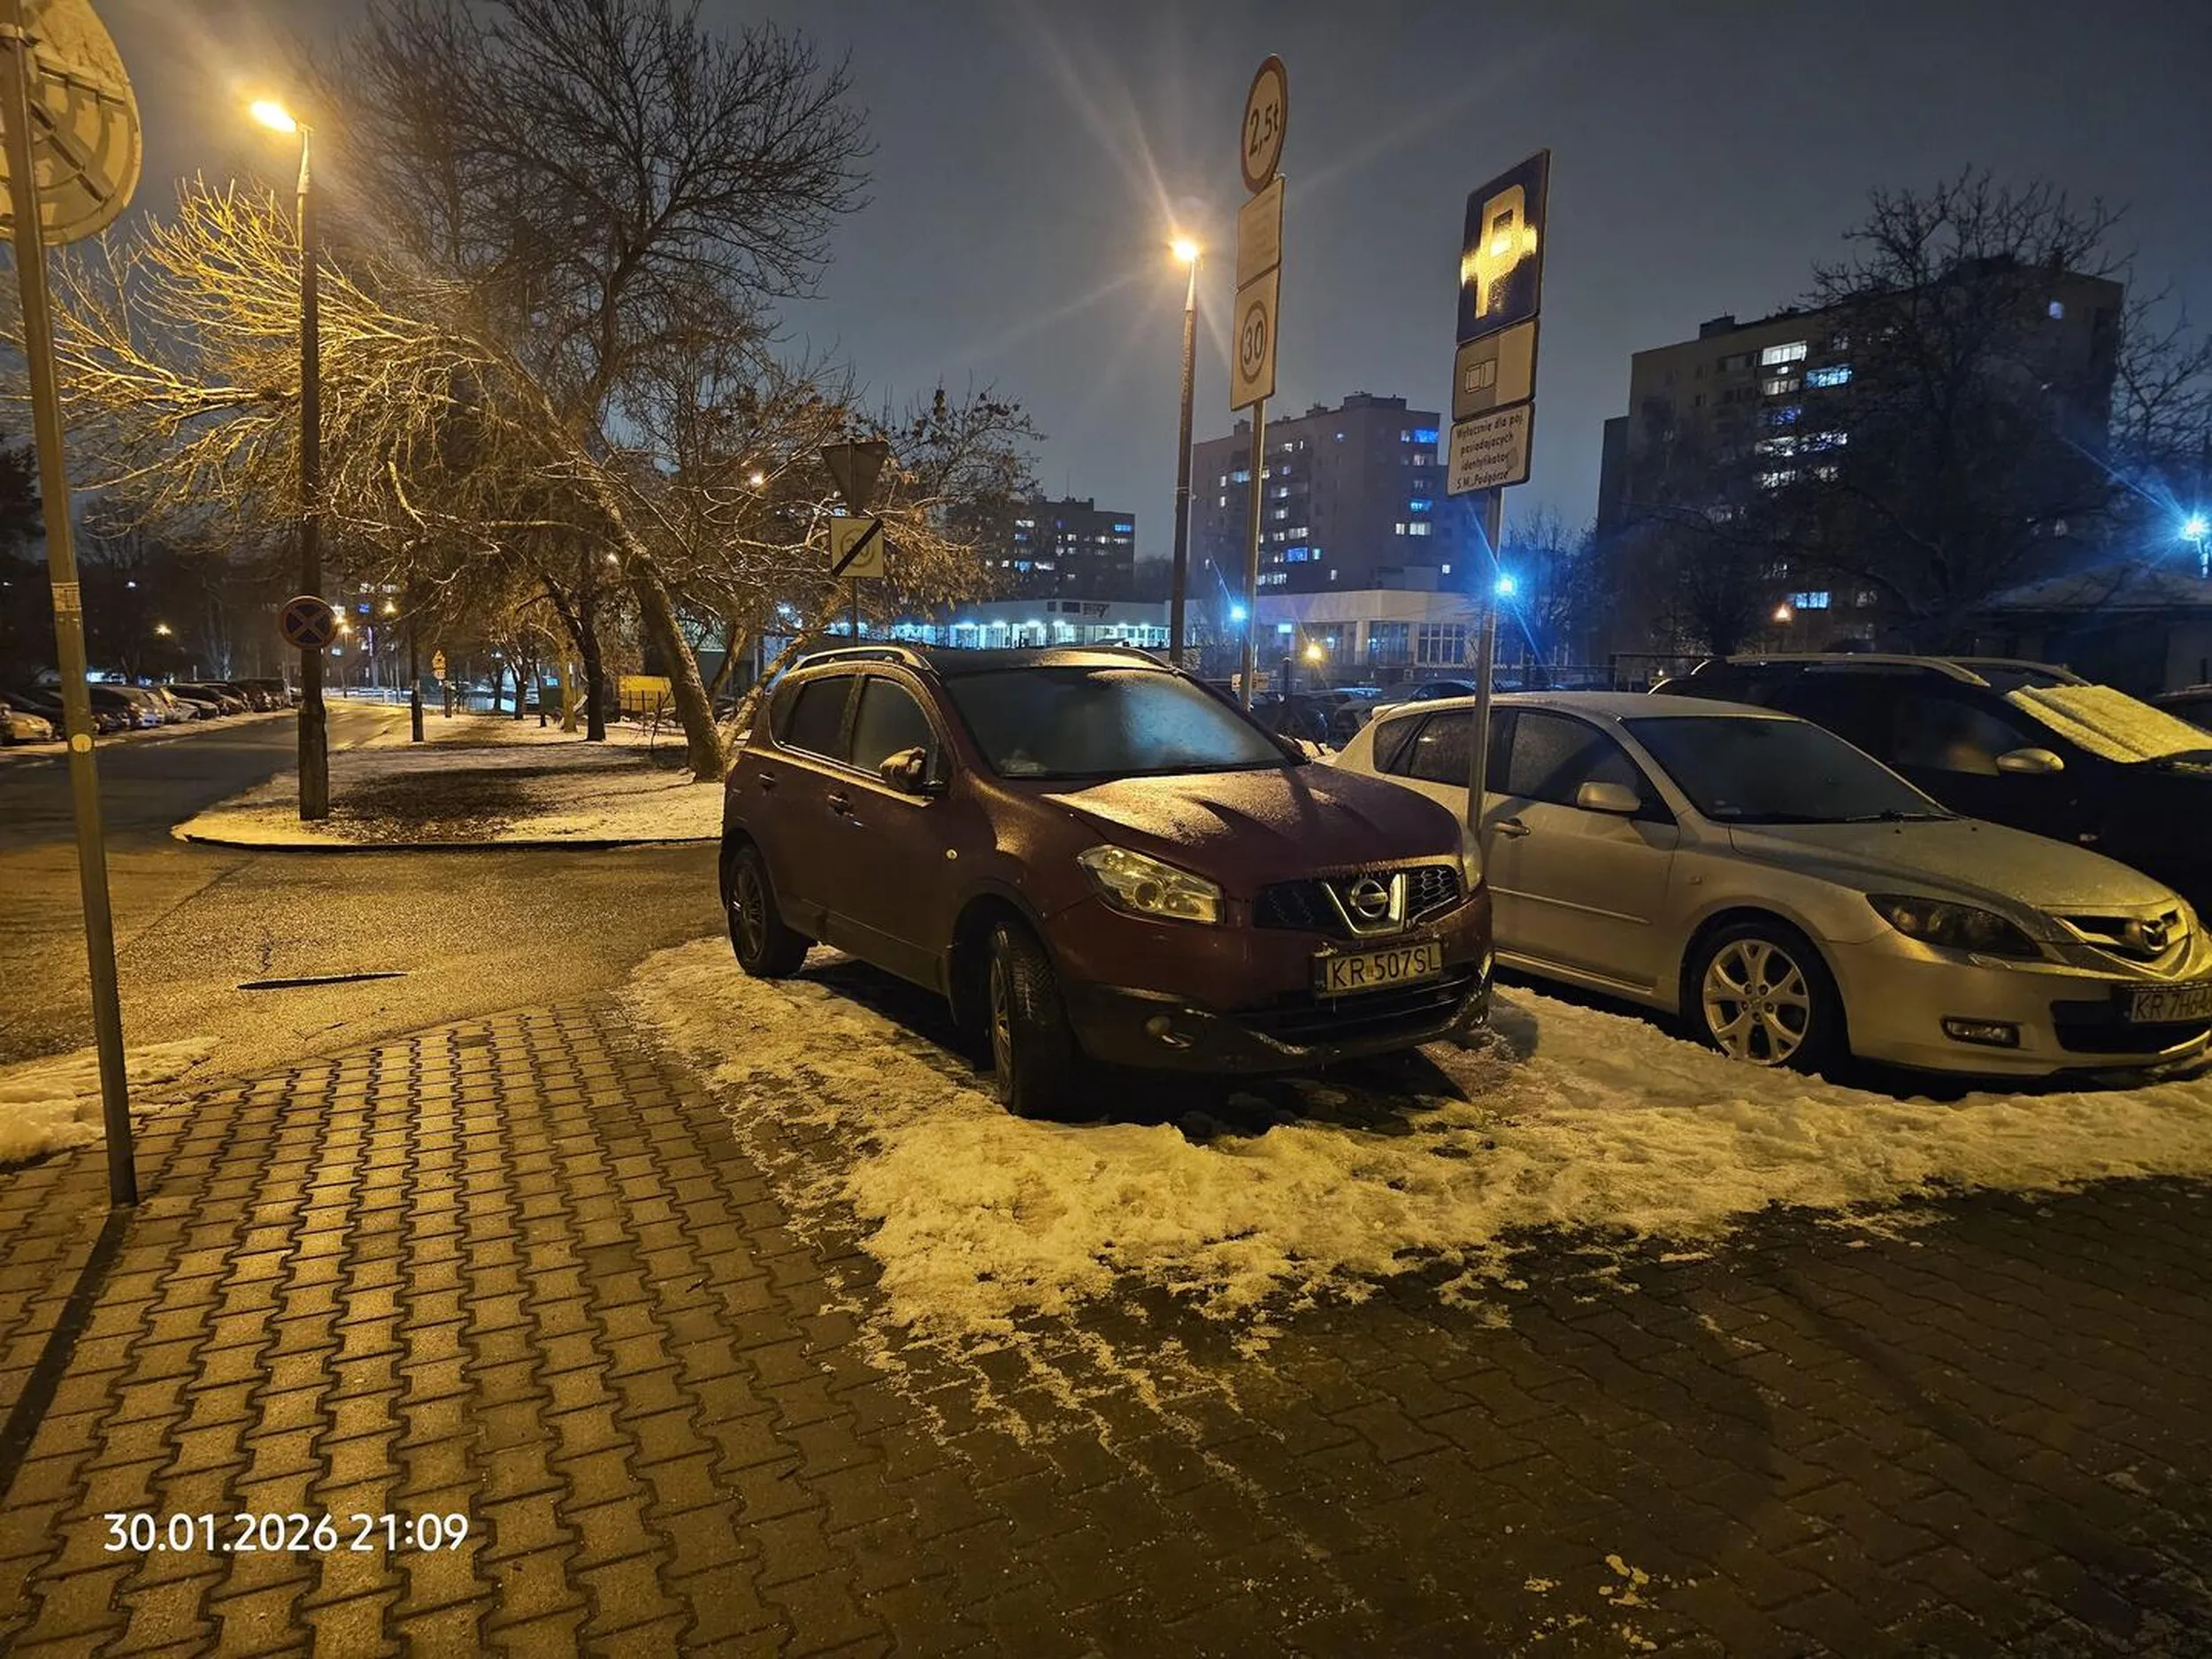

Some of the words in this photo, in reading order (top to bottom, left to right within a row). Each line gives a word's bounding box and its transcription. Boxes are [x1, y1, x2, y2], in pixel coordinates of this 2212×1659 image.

[1248, 98, 1279, 158] 2,5t
[1475, 184, 1525, 319] P
[1244, 319, 1263, 365] 30
[1332, 958, 1365, 988] KR
[1374, 946, 1440, 980] 507SL
